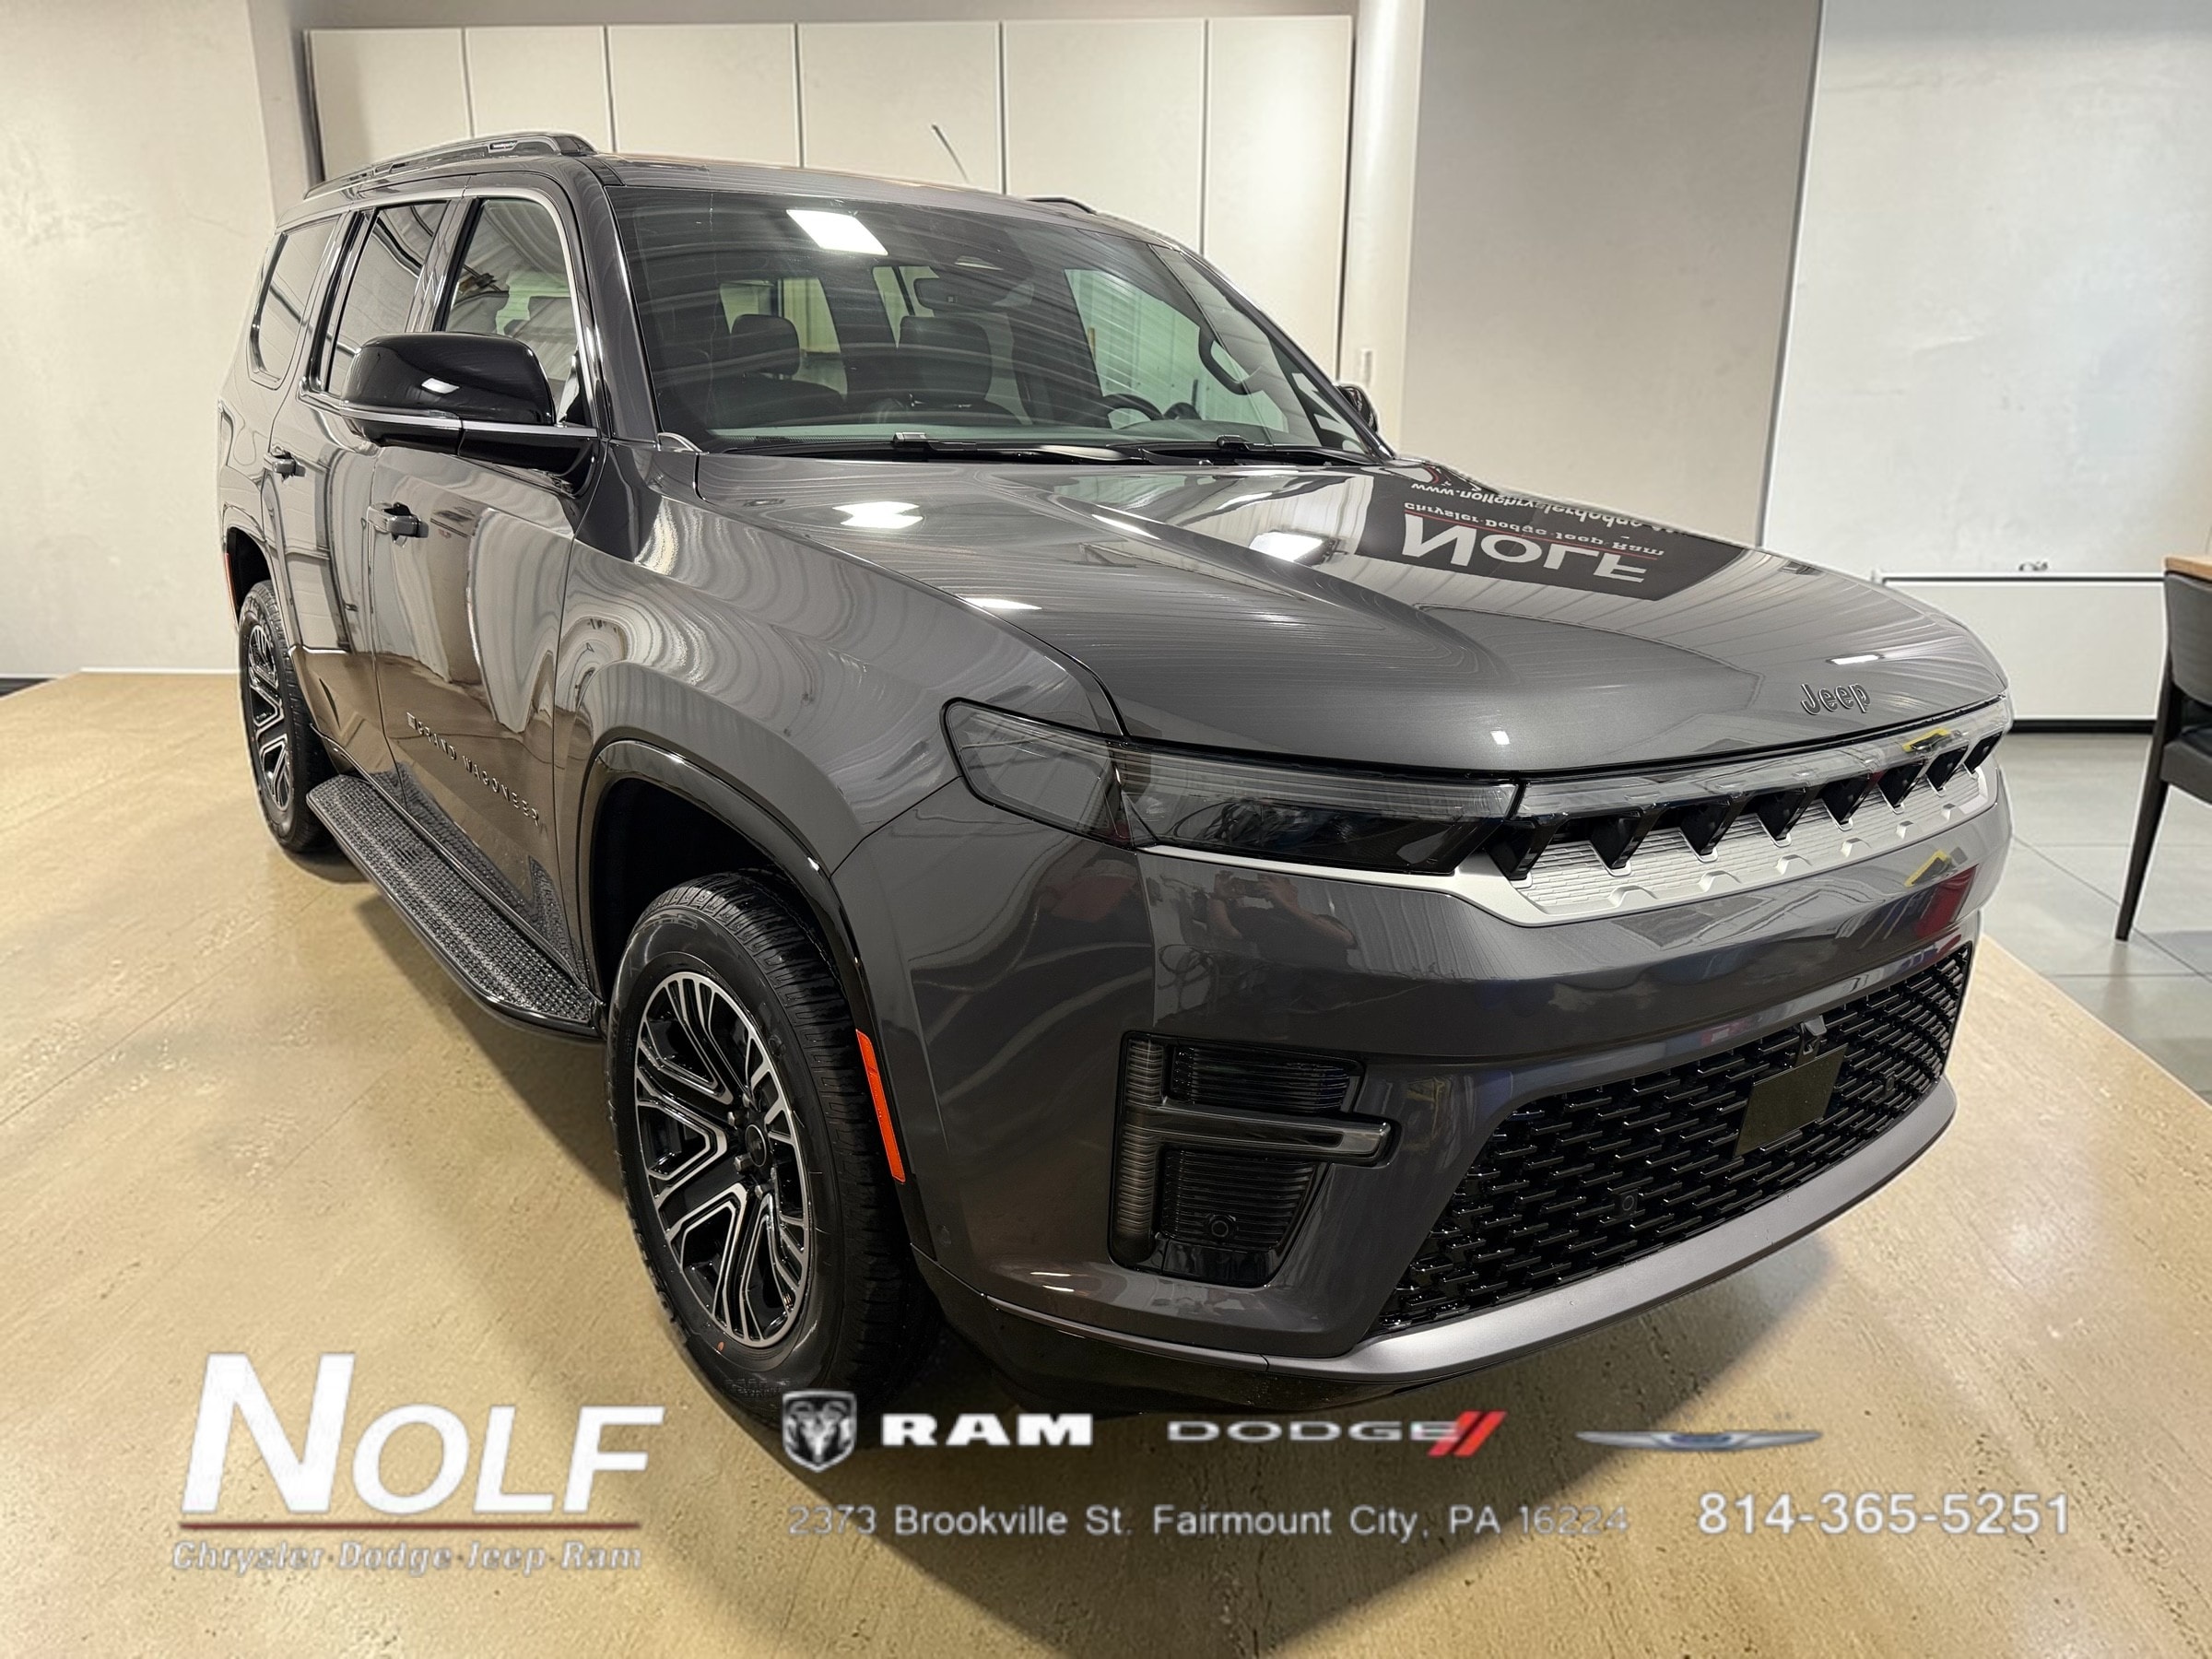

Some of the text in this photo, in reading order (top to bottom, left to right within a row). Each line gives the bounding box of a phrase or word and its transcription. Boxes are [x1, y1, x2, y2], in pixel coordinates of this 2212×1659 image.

[1800, 683, 1871, 715] Jeep
[416, 721, 540, 827] GRAND WAGONEER
